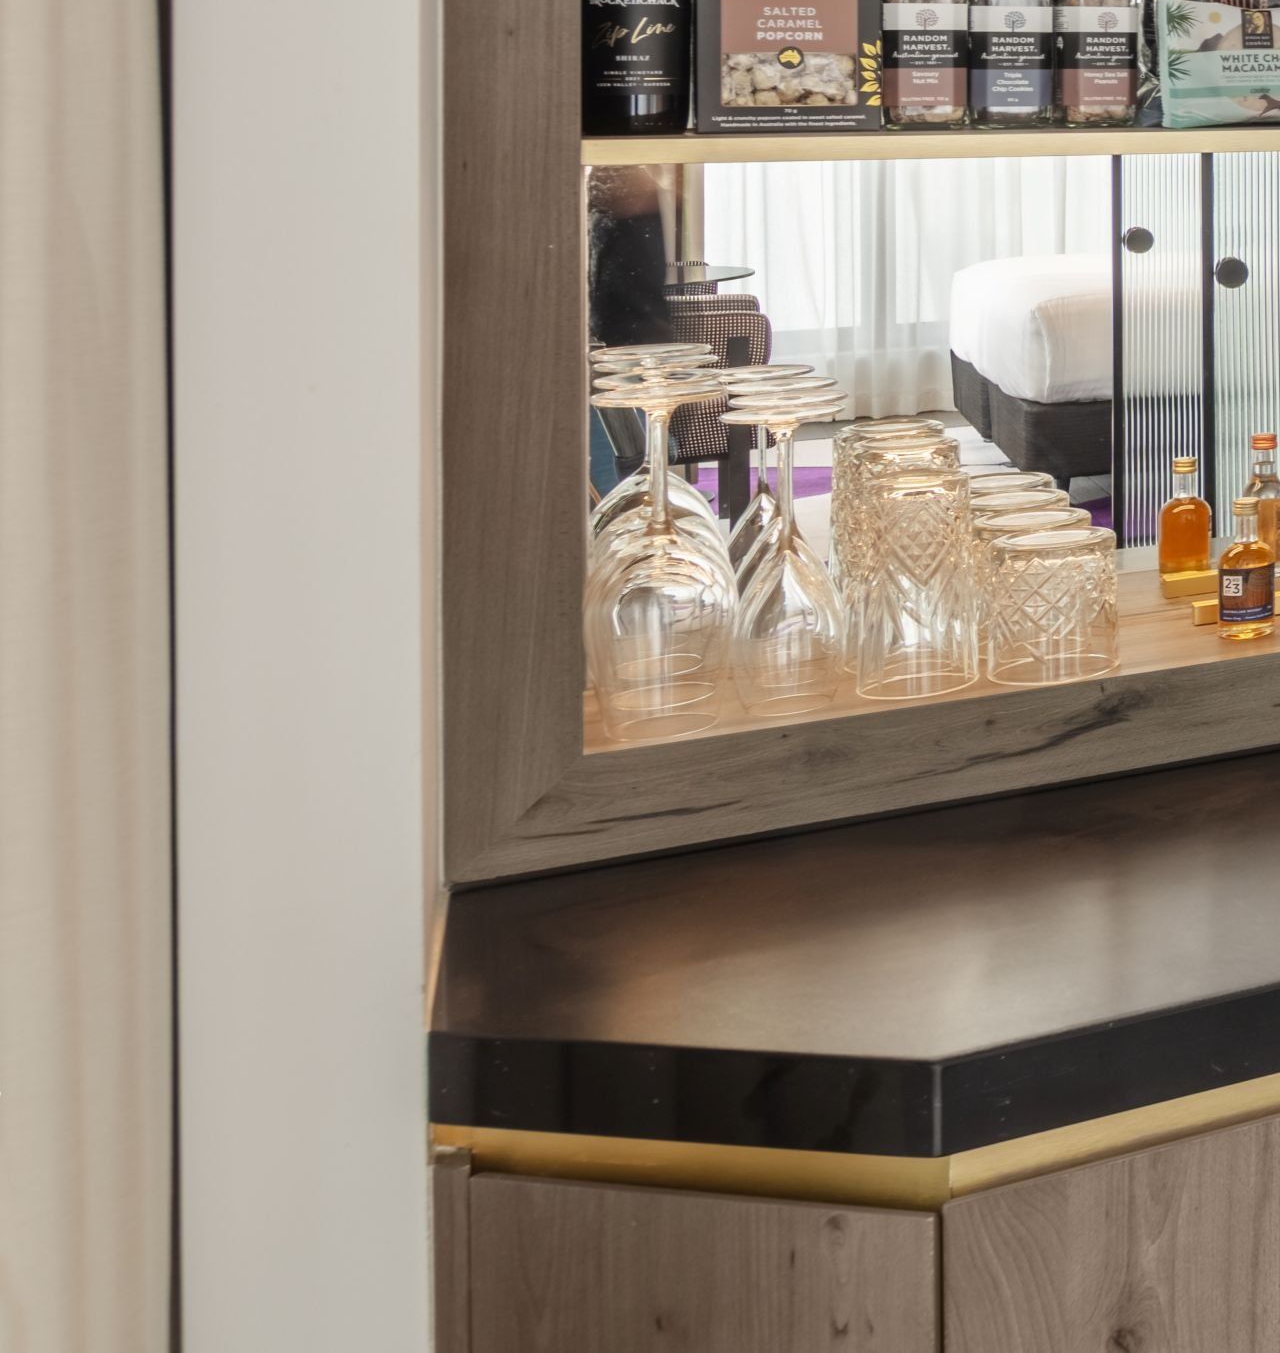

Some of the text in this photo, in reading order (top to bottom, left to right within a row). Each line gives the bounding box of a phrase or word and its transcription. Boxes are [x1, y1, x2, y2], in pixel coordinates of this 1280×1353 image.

[763, 6, 817, 16] SALTED
[756, 19, 823, 29] CARAMEL
[756, 31, 823, 41] POPCORN
[991, 36, 1035, 44] RANDOM
[1085, 36, 1127, 44] RANDOM
[1220, 53, 1260, 63] WHITE
